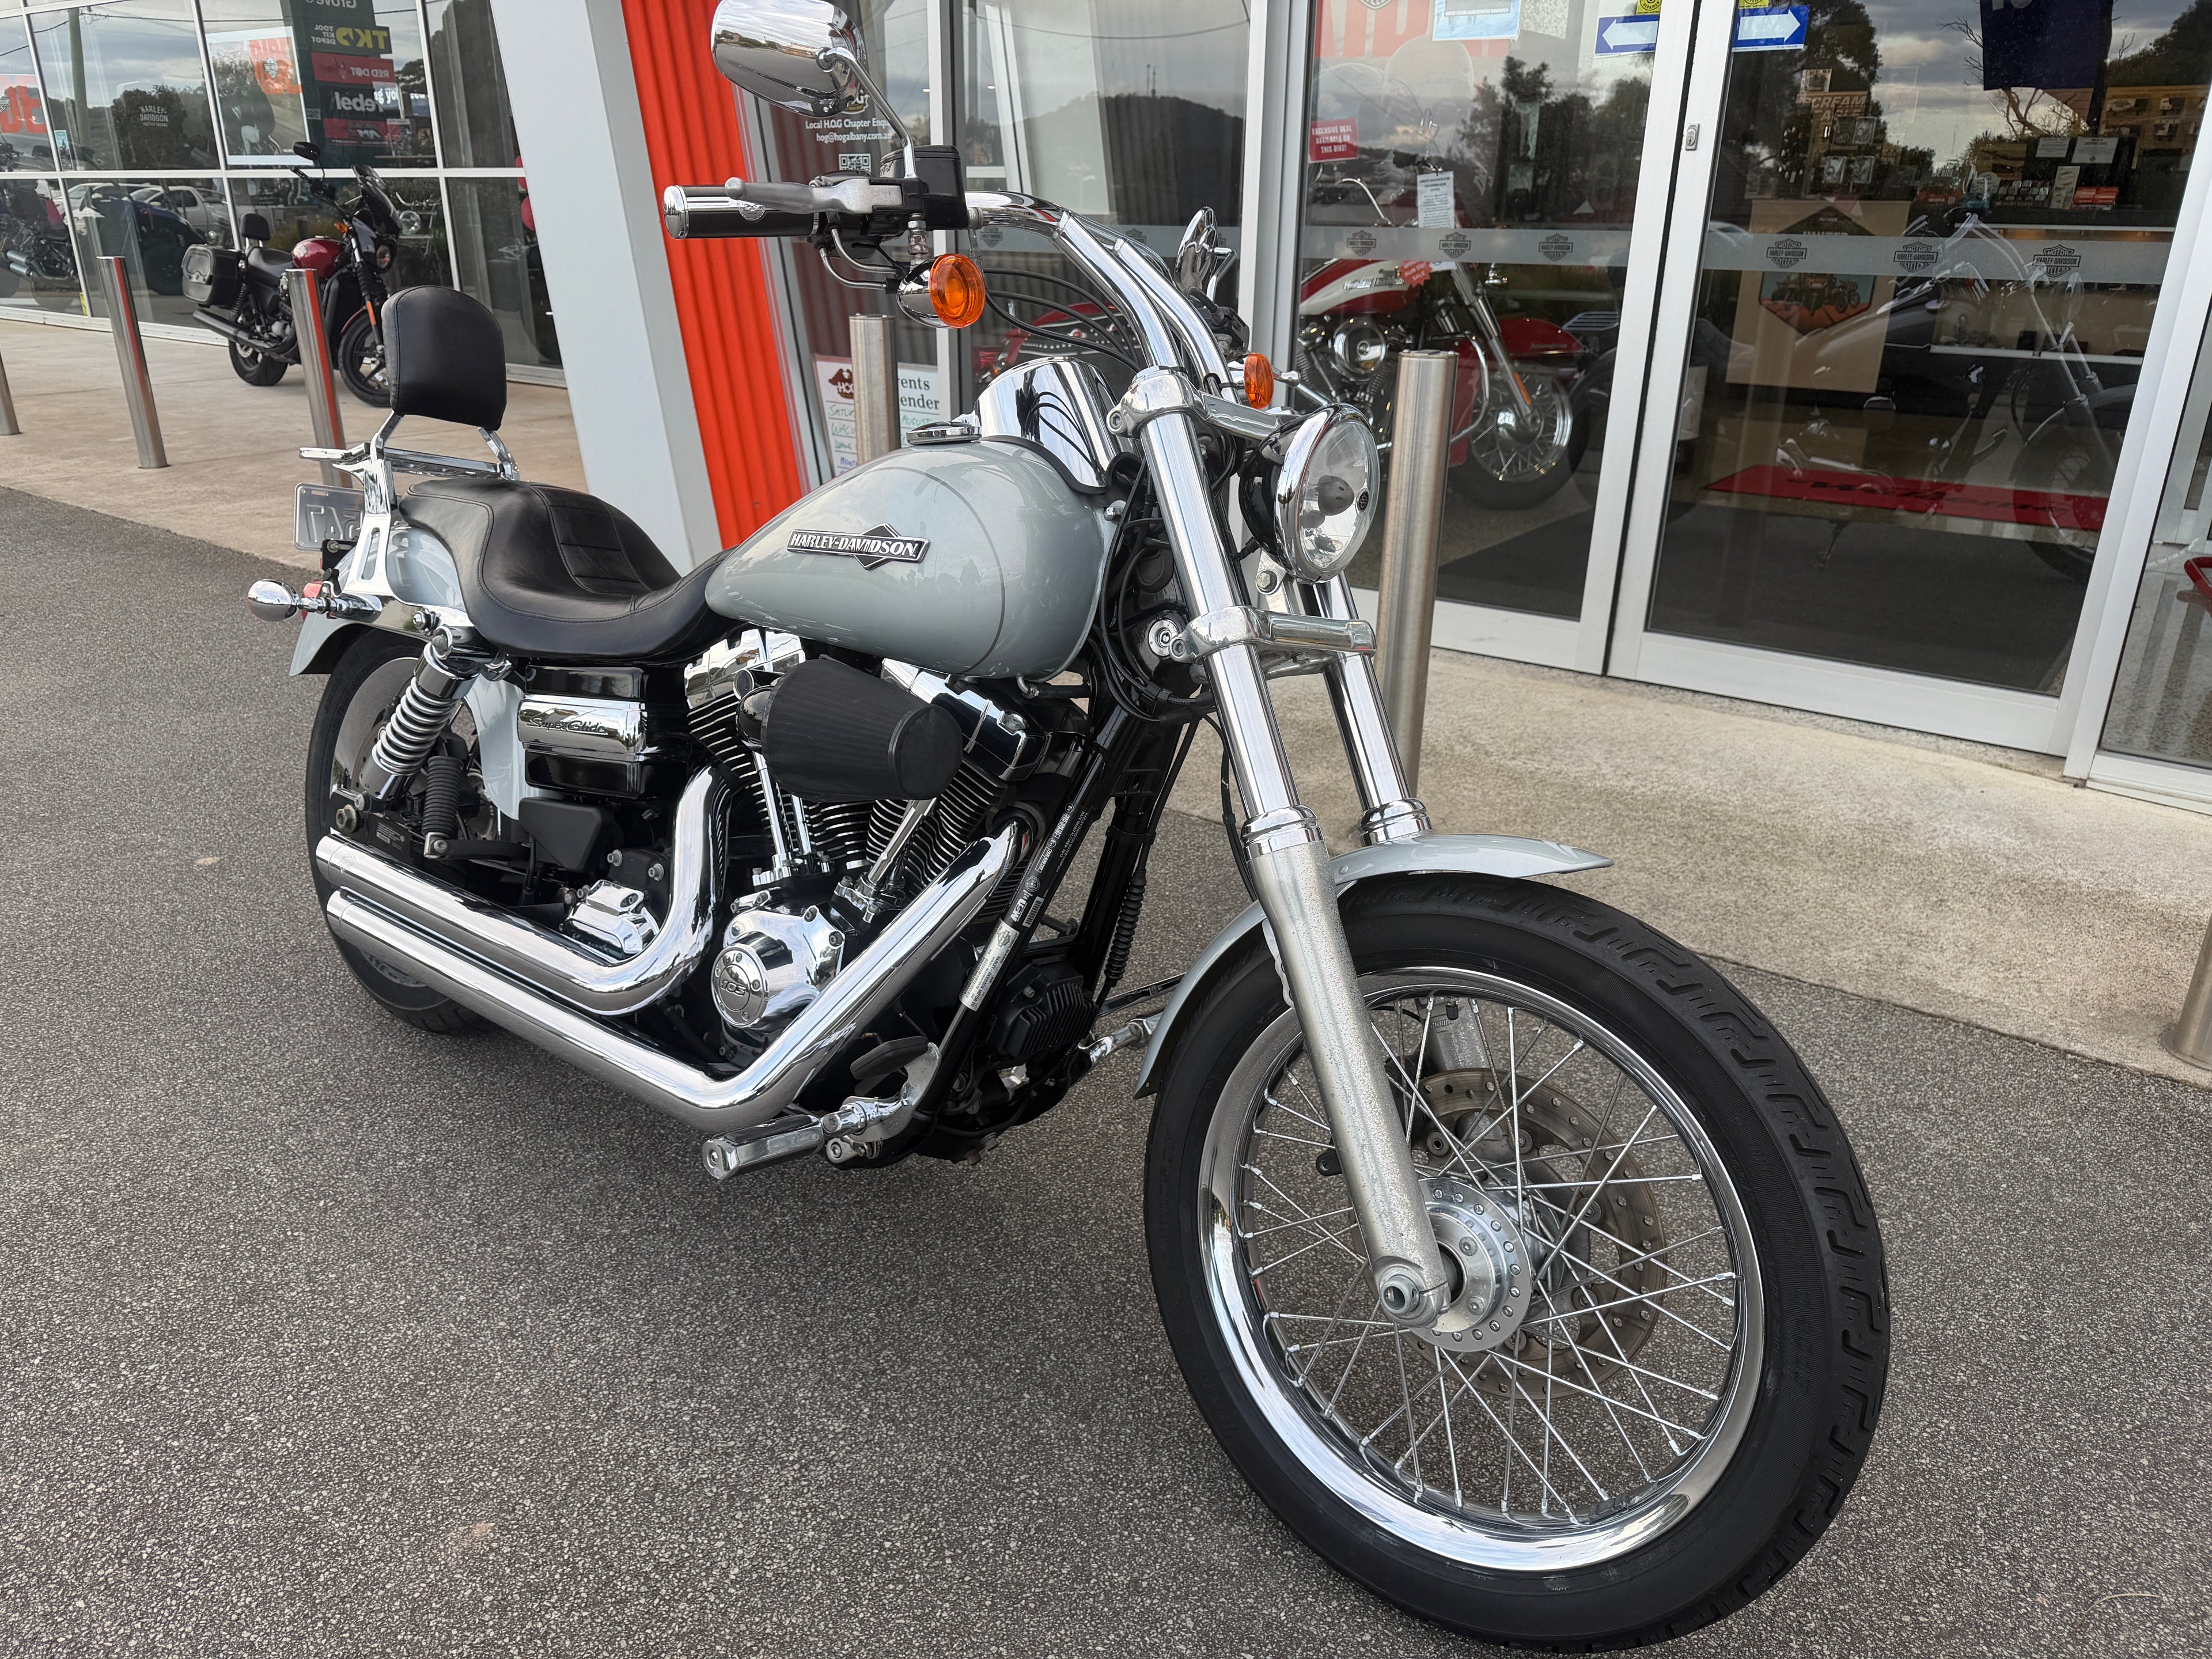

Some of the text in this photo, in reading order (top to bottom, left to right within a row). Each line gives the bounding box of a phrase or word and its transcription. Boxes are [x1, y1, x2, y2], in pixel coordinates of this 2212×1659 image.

[139, 113, 169, 122] DAVIDSON
[805, 120, 823, 130] Local
[844, 119, 870, 130] Chapter
[1769, 249, 1804, 257] HARLEY-DAVIDSON
[1896, 252, 1936, 262] HARLEY-DAVIDSON
[2036, 256, 2077, 266] HARLEY-DAVIDSON
[898, 376, 930, 391] ents
[900, 393, 940, 410] ender
[790, 533, 918, 558] HARLEY-DAVIDSON
[527, 716, 607, 734] Super Glide
[1745, 1136, 1809, 1275] DUNLOP
